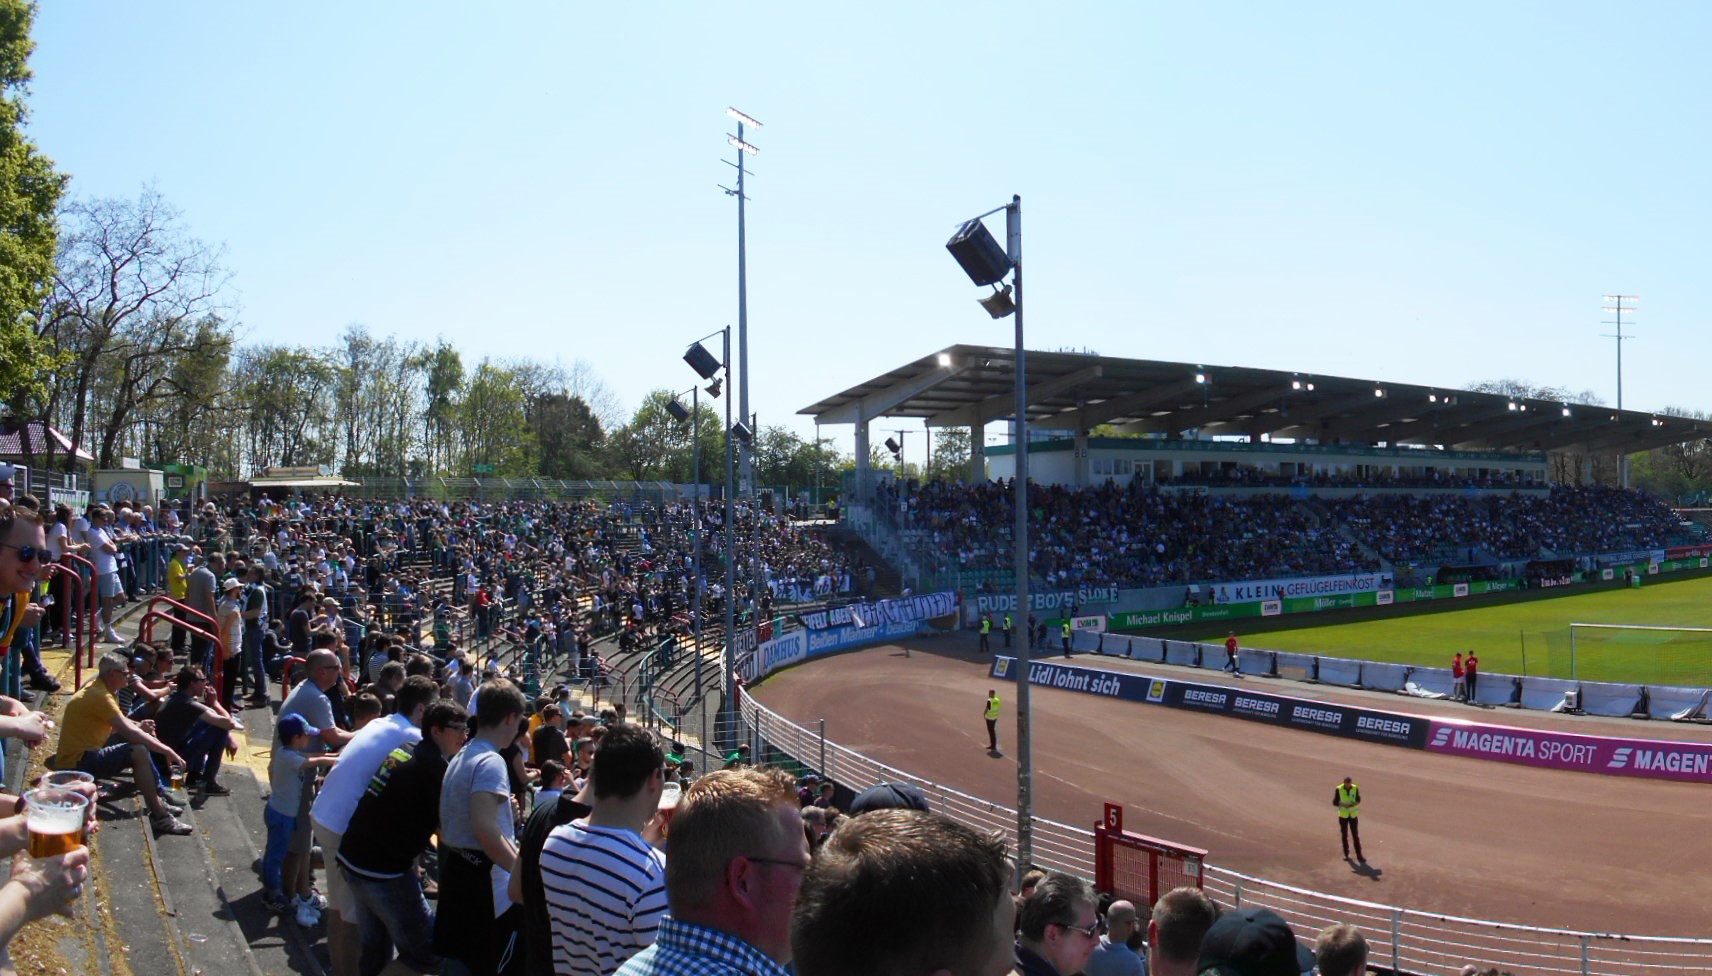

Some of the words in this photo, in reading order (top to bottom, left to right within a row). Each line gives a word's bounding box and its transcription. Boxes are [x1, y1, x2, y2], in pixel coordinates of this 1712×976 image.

[1235, 585, 1280, 600] KLEIN
[1287, 577, 1376, 595] GEFLÜGELFEINKOST
[977, 595, 1018, 612] RUDE
[1126, 615, 1161, 626] Michael
[1163, 610, 1193, 625] Knispel
[1028, 664, 1052, 684] Lidl
[1053, 668, 1089, 690] lohnt
[1090, 674, 1121, 696] sich
[1184, 689, 1227, 704] BERESA
[1234, 697, 1280, 714] BERESA
[1292, 706, 1343, 724] BERESA
[1357, 716, 1411, 734] BERESA
[1452, 730, 1535, 758] MAGENTA
[1538, 743, 1598, 765] SPORT
[1109, 808, 1117, 827] 5
